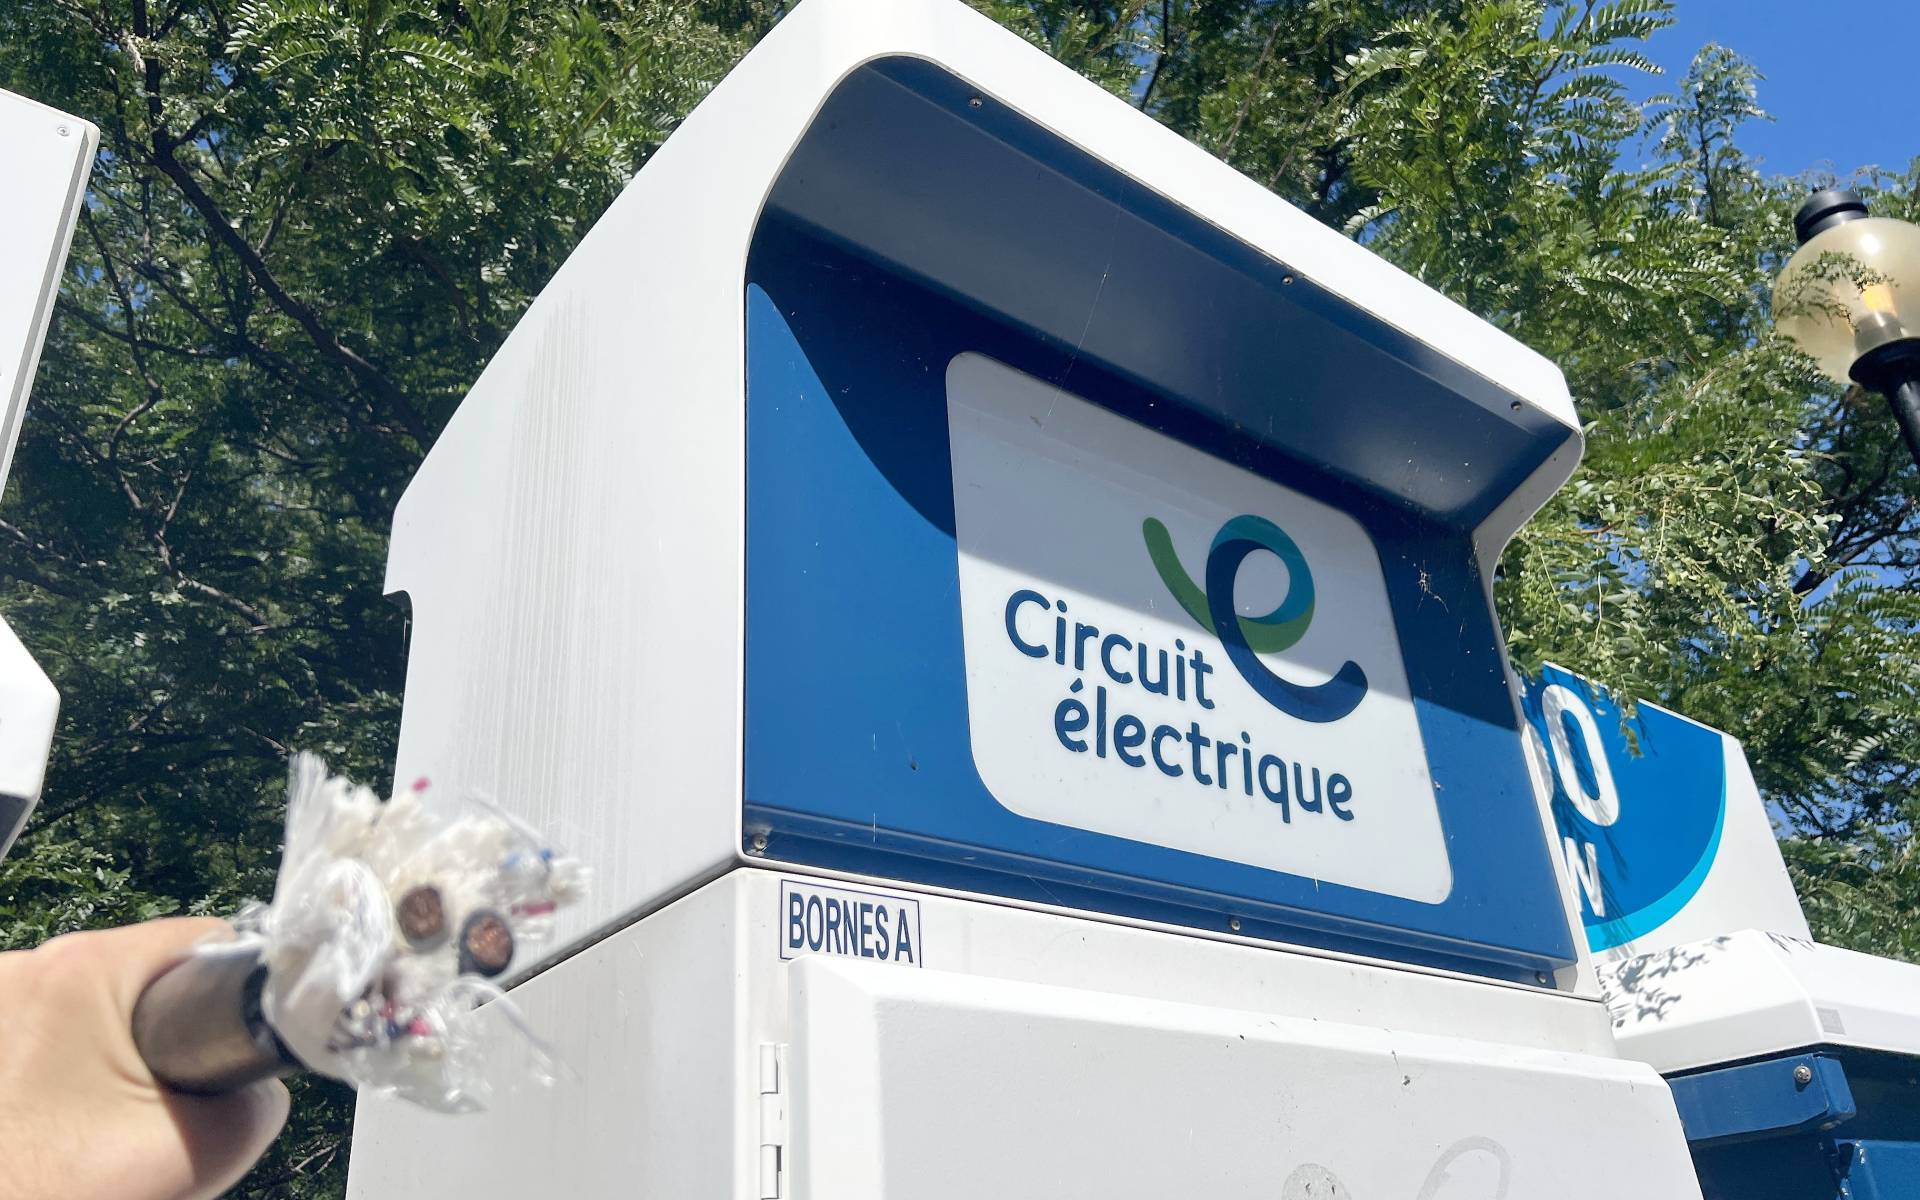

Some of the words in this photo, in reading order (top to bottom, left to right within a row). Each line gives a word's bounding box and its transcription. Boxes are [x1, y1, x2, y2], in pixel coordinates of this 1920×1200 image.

[1005, 590, 1215, 709] Circuit
[1054, 677, 1355, 824] électrique
[789, 891, 890, 961] BORNES
[894, 908, 914, 964] A
